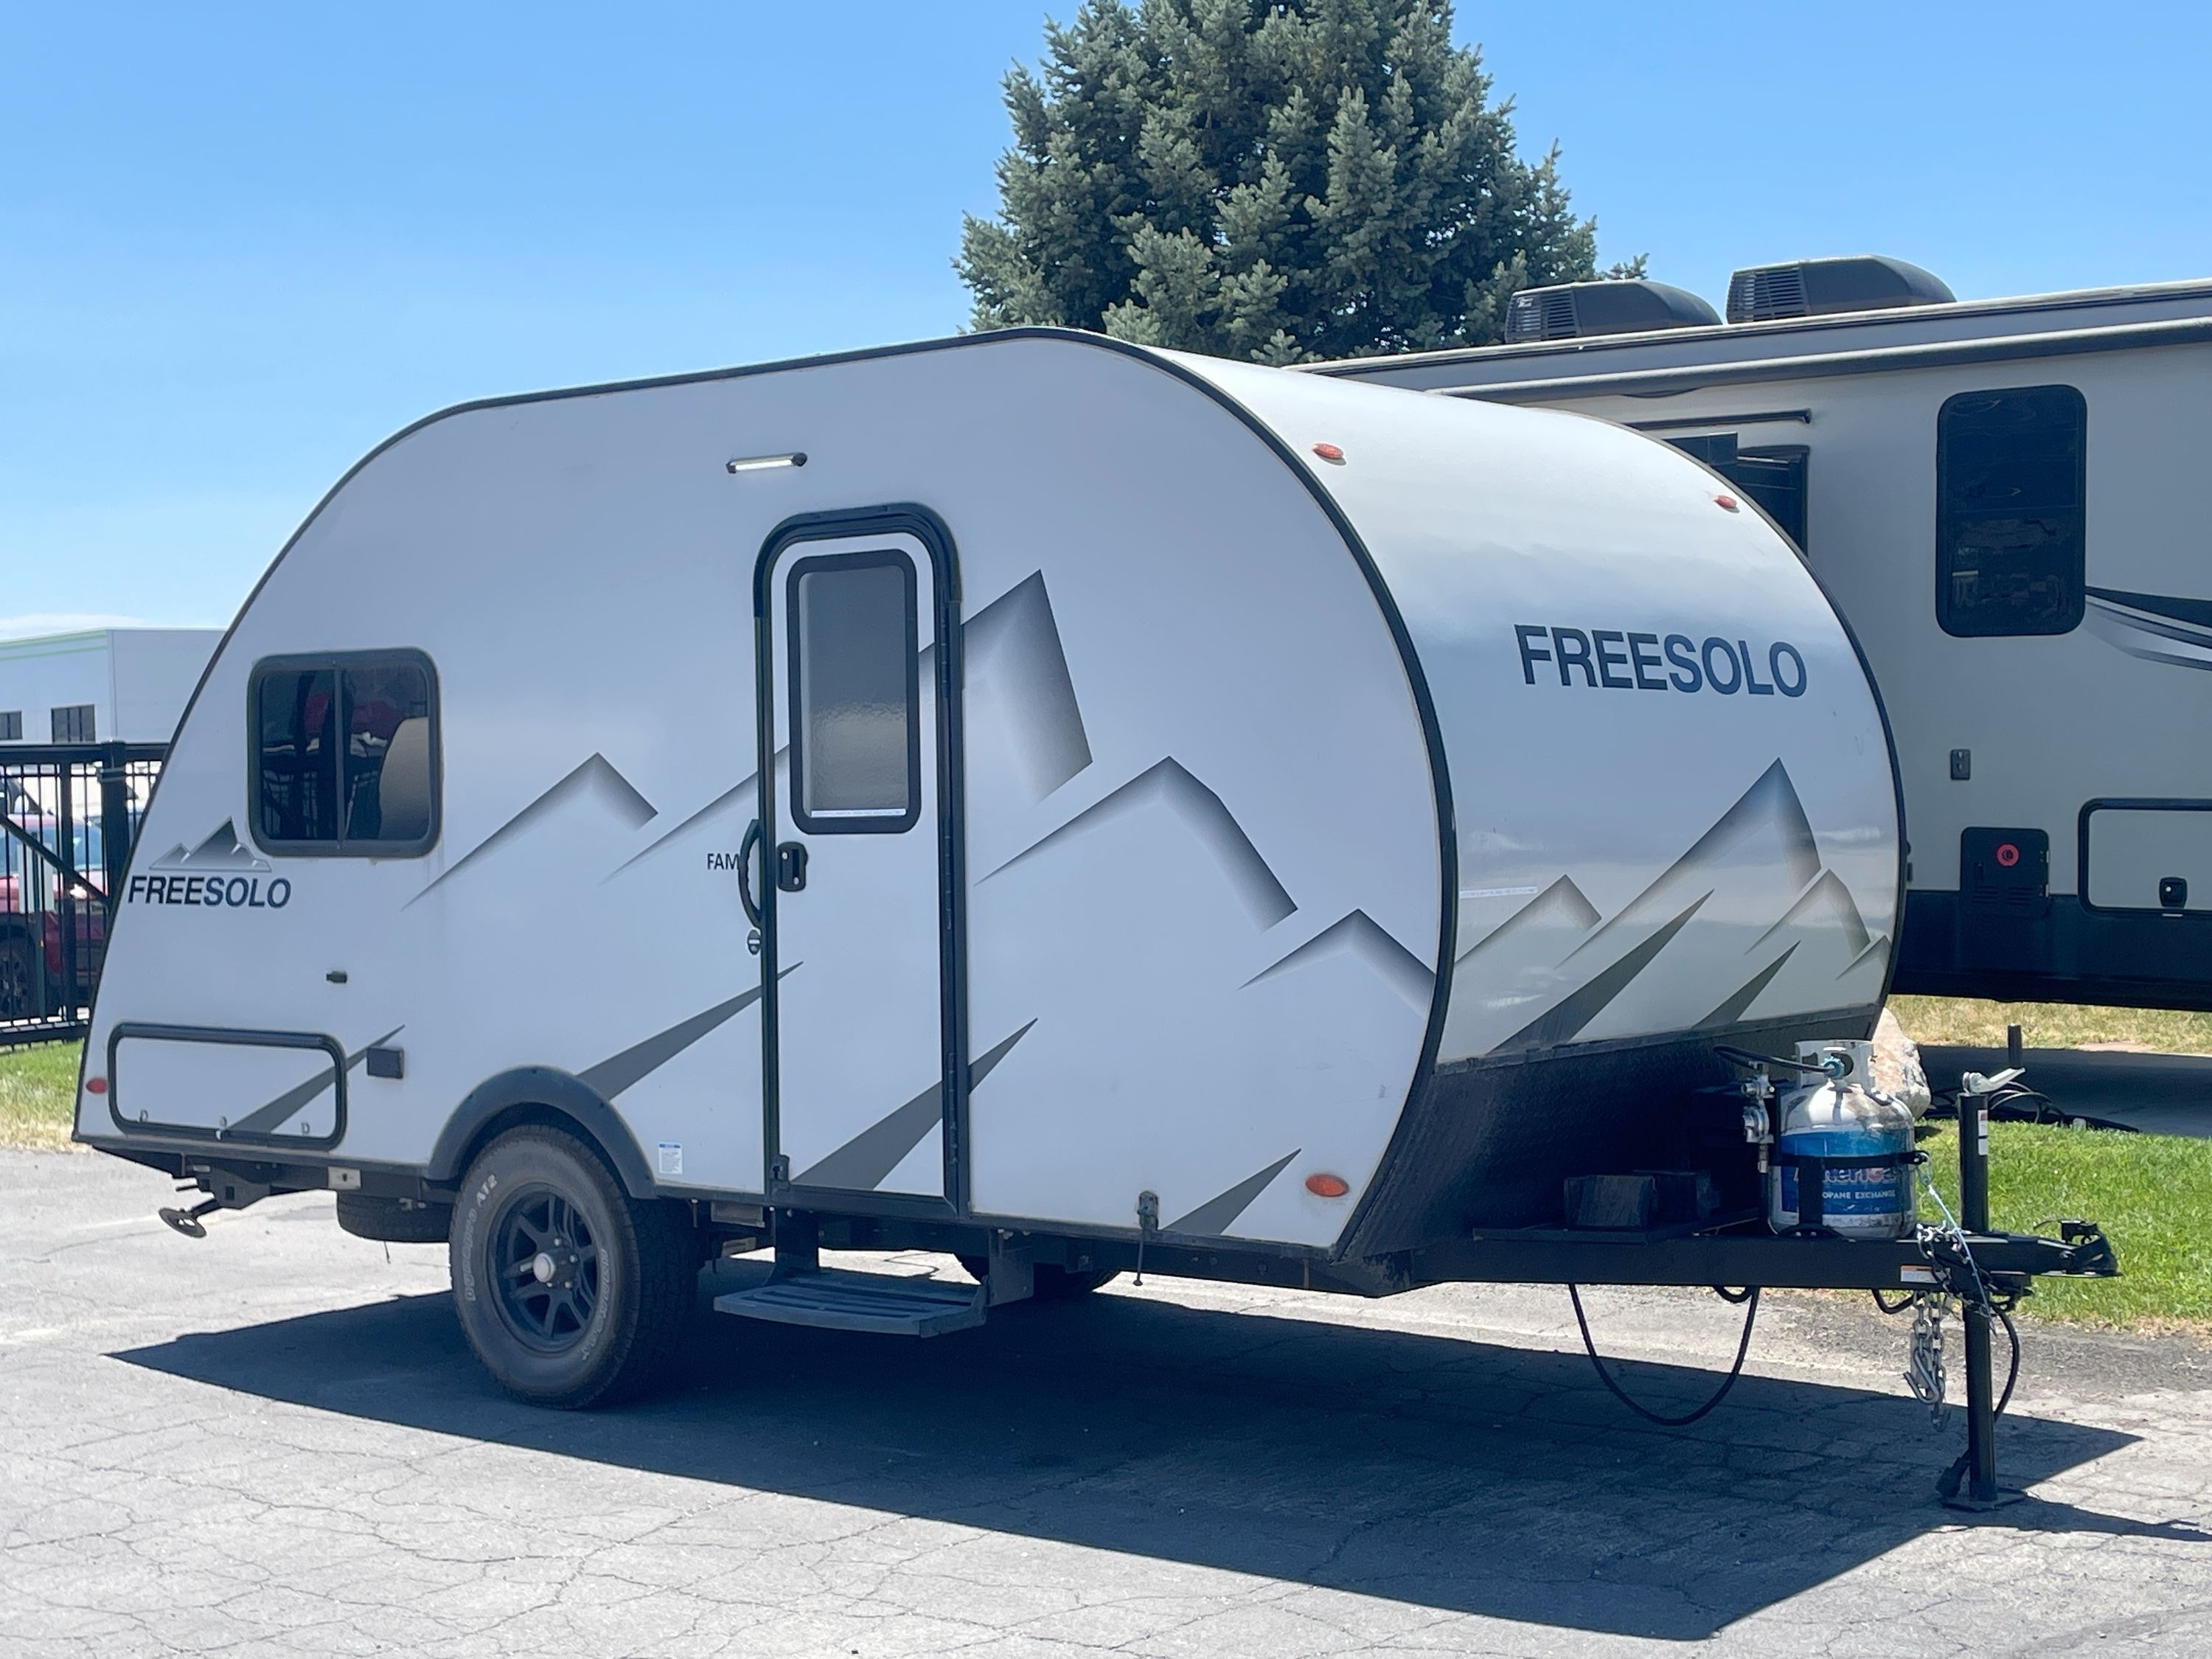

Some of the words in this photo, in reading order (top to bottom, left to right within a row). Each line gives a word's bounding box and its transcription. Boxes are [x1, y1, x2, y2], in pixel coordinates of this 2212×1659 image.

[1514, 624, 1808, 698] FREESOLO
[128, 875, 292, 908] FREESOLO
[476, 1174, 498, 1208] AT2
[1822, 1191, 1851, 1200] OPANE
